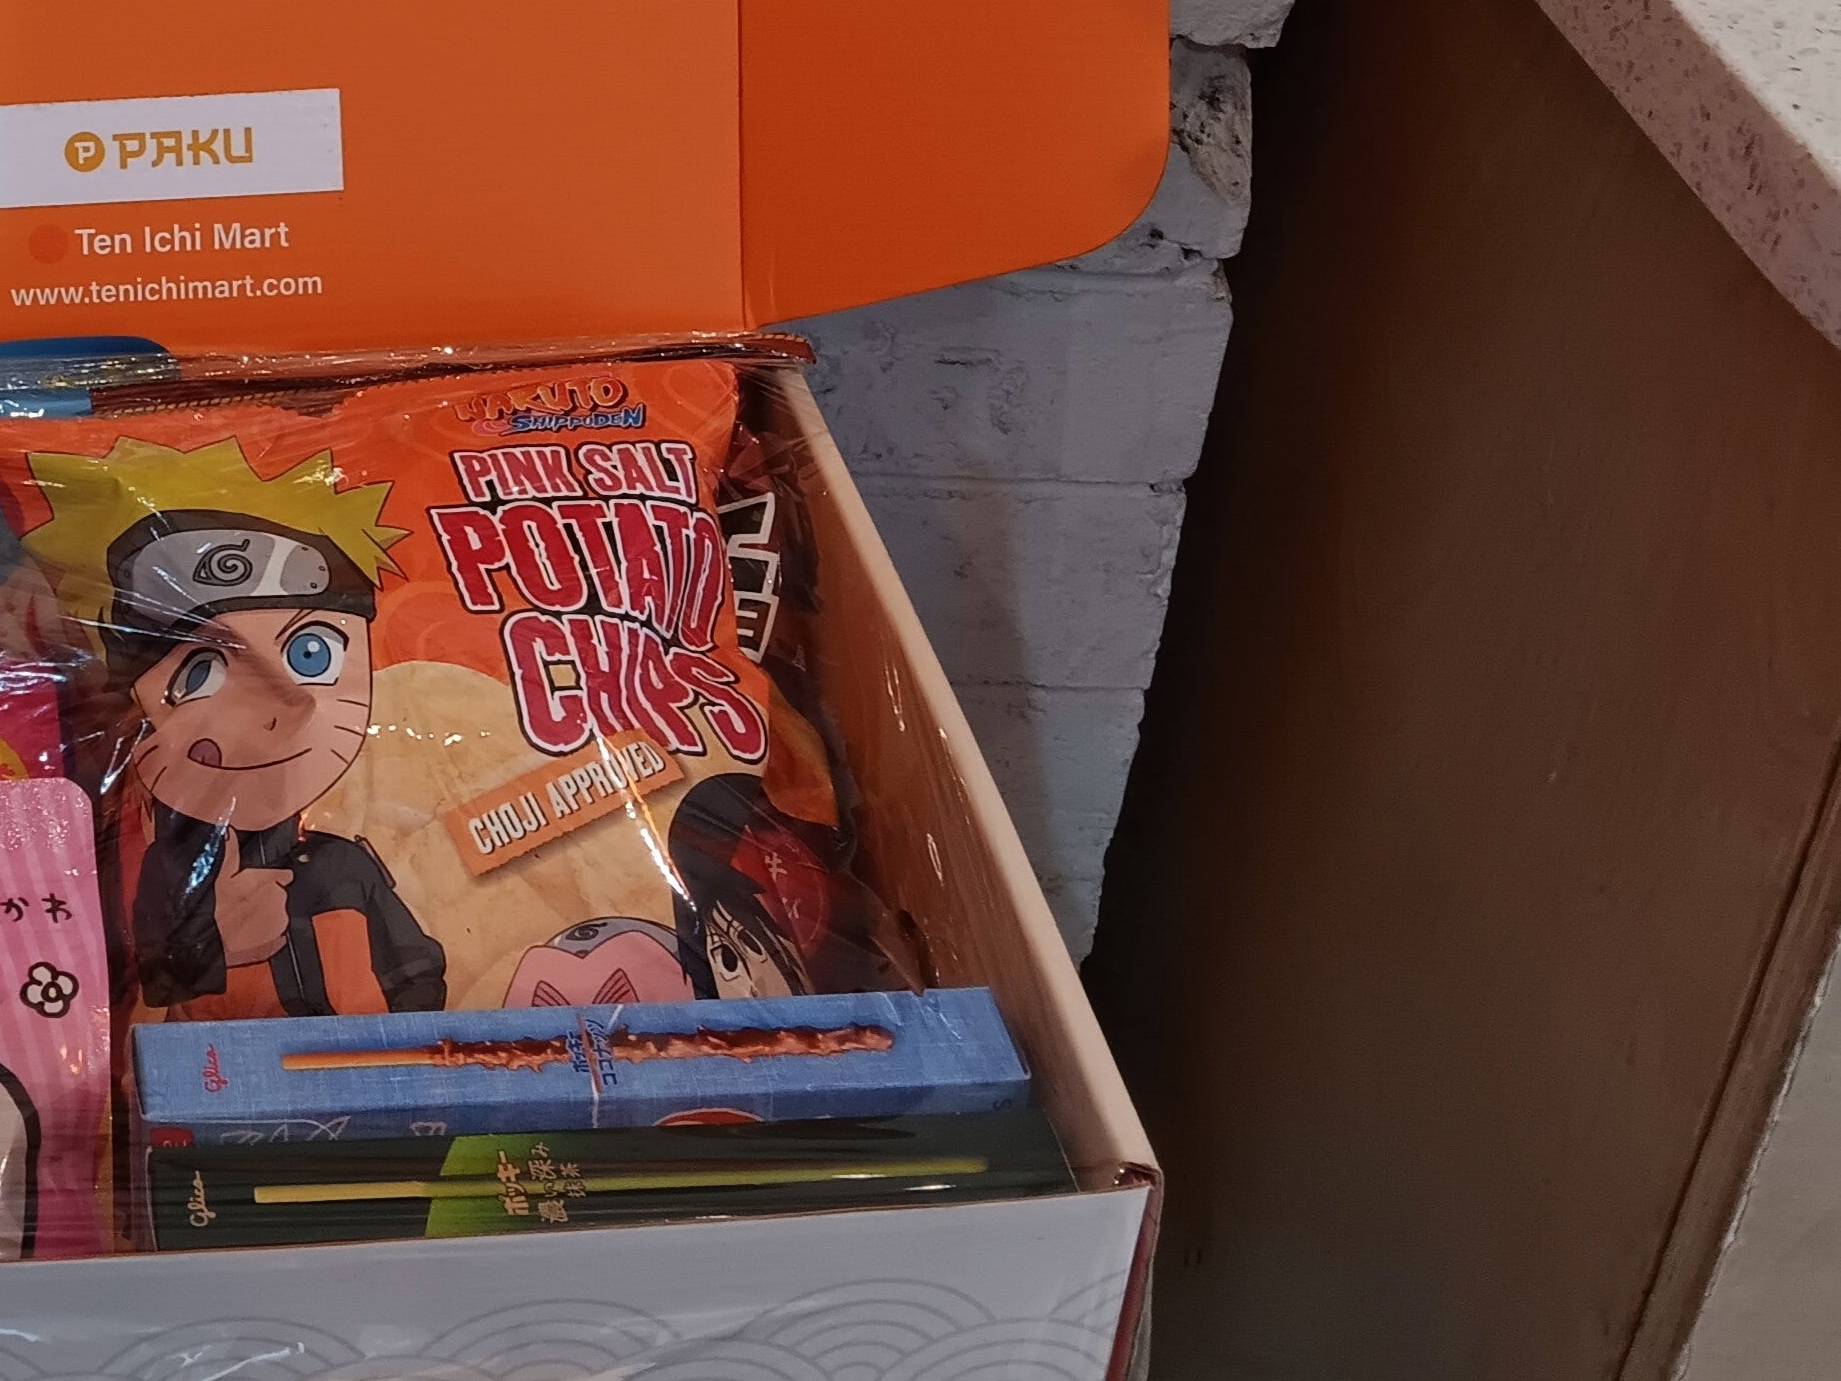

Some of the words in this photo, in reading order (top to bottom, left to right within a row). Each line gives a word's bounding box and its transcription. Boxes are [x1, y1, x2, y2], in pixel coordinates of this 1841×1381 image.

[112, 126, 254, 170] PAKU
[75, 228, 133, 256] Ten
[144, 224, 202, 253] Ichi
[213, 221, 290, 250] Mart
[10, 274, 323, 307] www.tenichimart.com
[454, 376, 629, 421] NARUTO
[505, 403, 646, 434] SHIPPUDEN
[456, 445, 578, 503] PINK
[578, 442, 698, 504] SALT
[430, 501, 726, 651] POTATO
[505, 611, 768, 762] CHIPS
[468, 800, 549, 856] CHOJI
[548, 742, 666, 820] APPROVED
[202, 1042, 229, 1093] Glico
[187, 1170, 217, 1227] Glico
[497, 1150, 530, 1216] ポッキー
